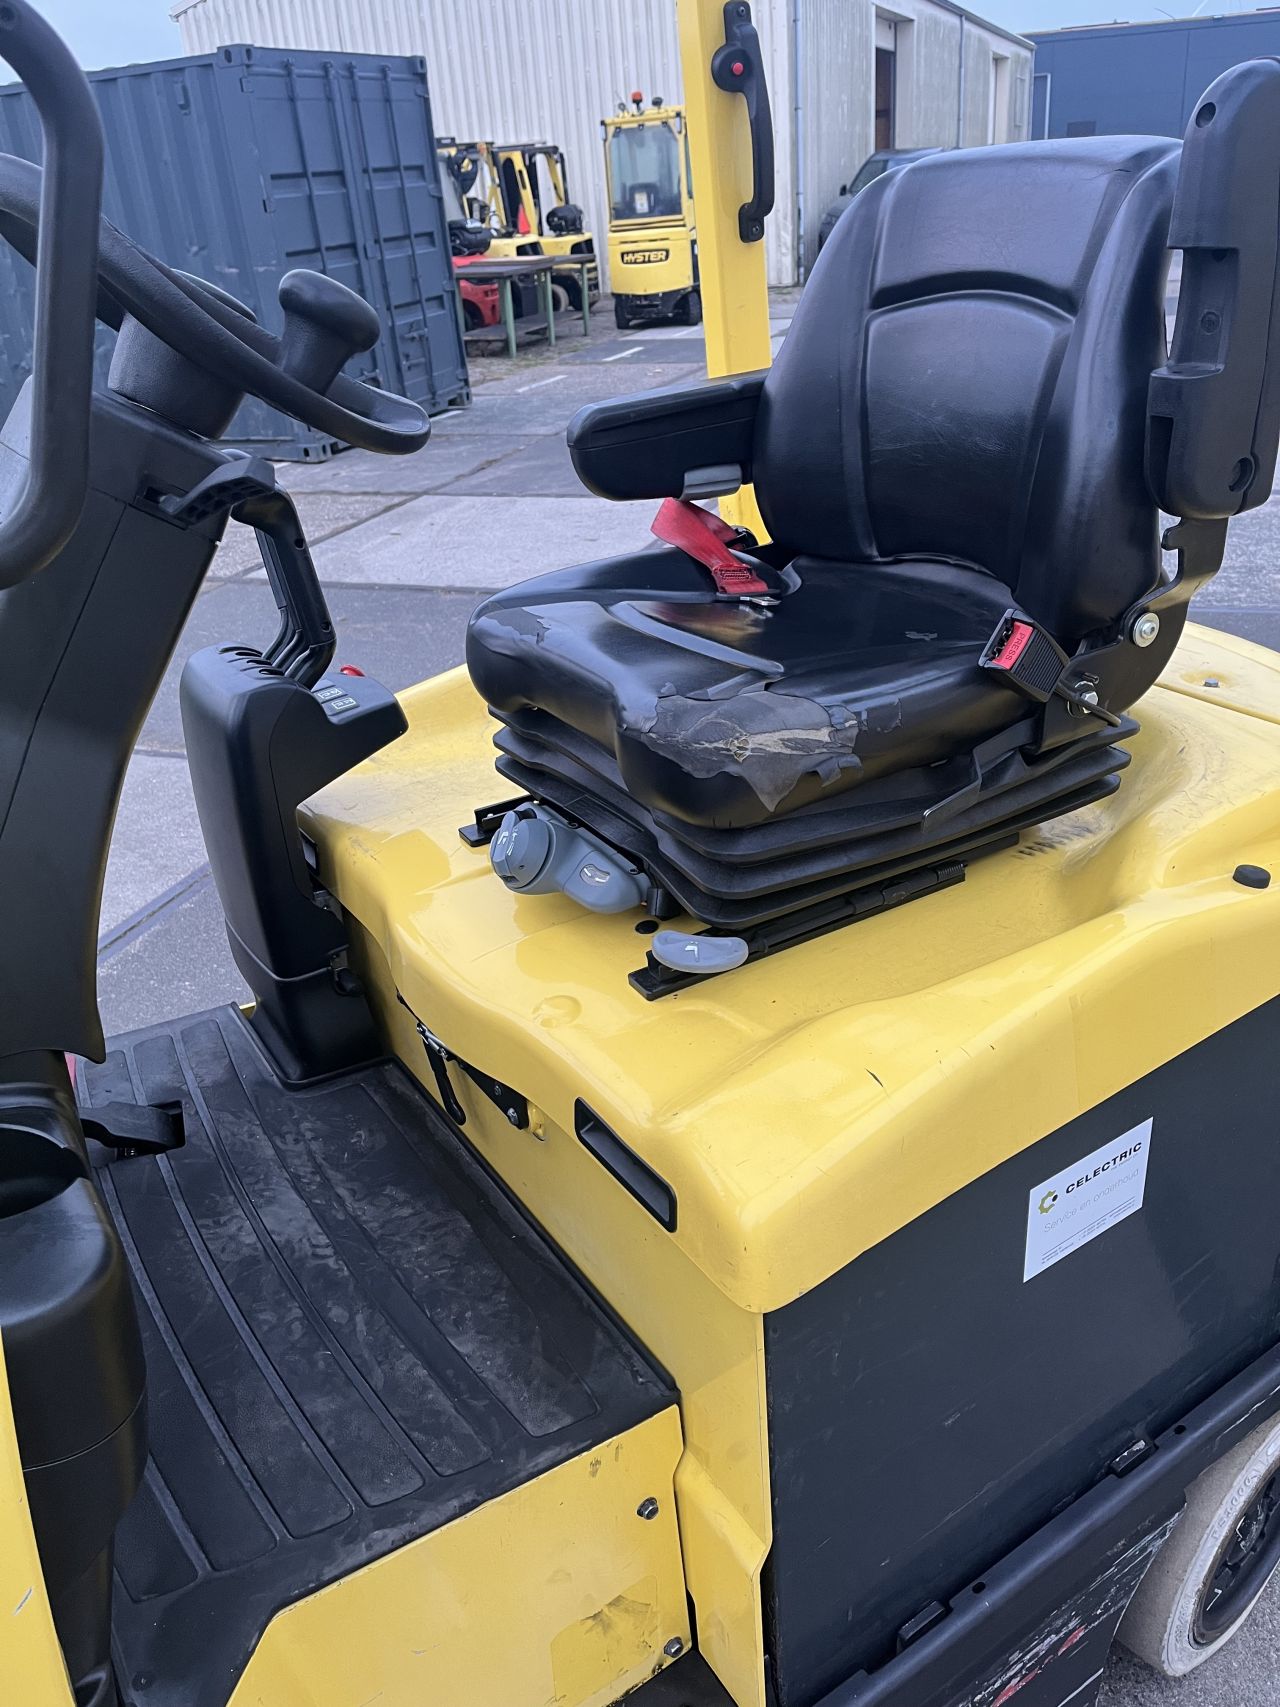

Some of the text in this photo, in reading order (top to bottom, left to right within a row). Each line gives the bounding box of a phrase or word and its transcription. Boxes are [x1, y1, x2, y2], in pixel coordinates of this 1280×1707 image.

[623, 250, 667, 263] HYSTER
[1005, 633, 1025, 660] PRESS
[1066, 1142, 1142, 1194] CELECTRIC
[1044, 1209, 1077, 1232] Service
